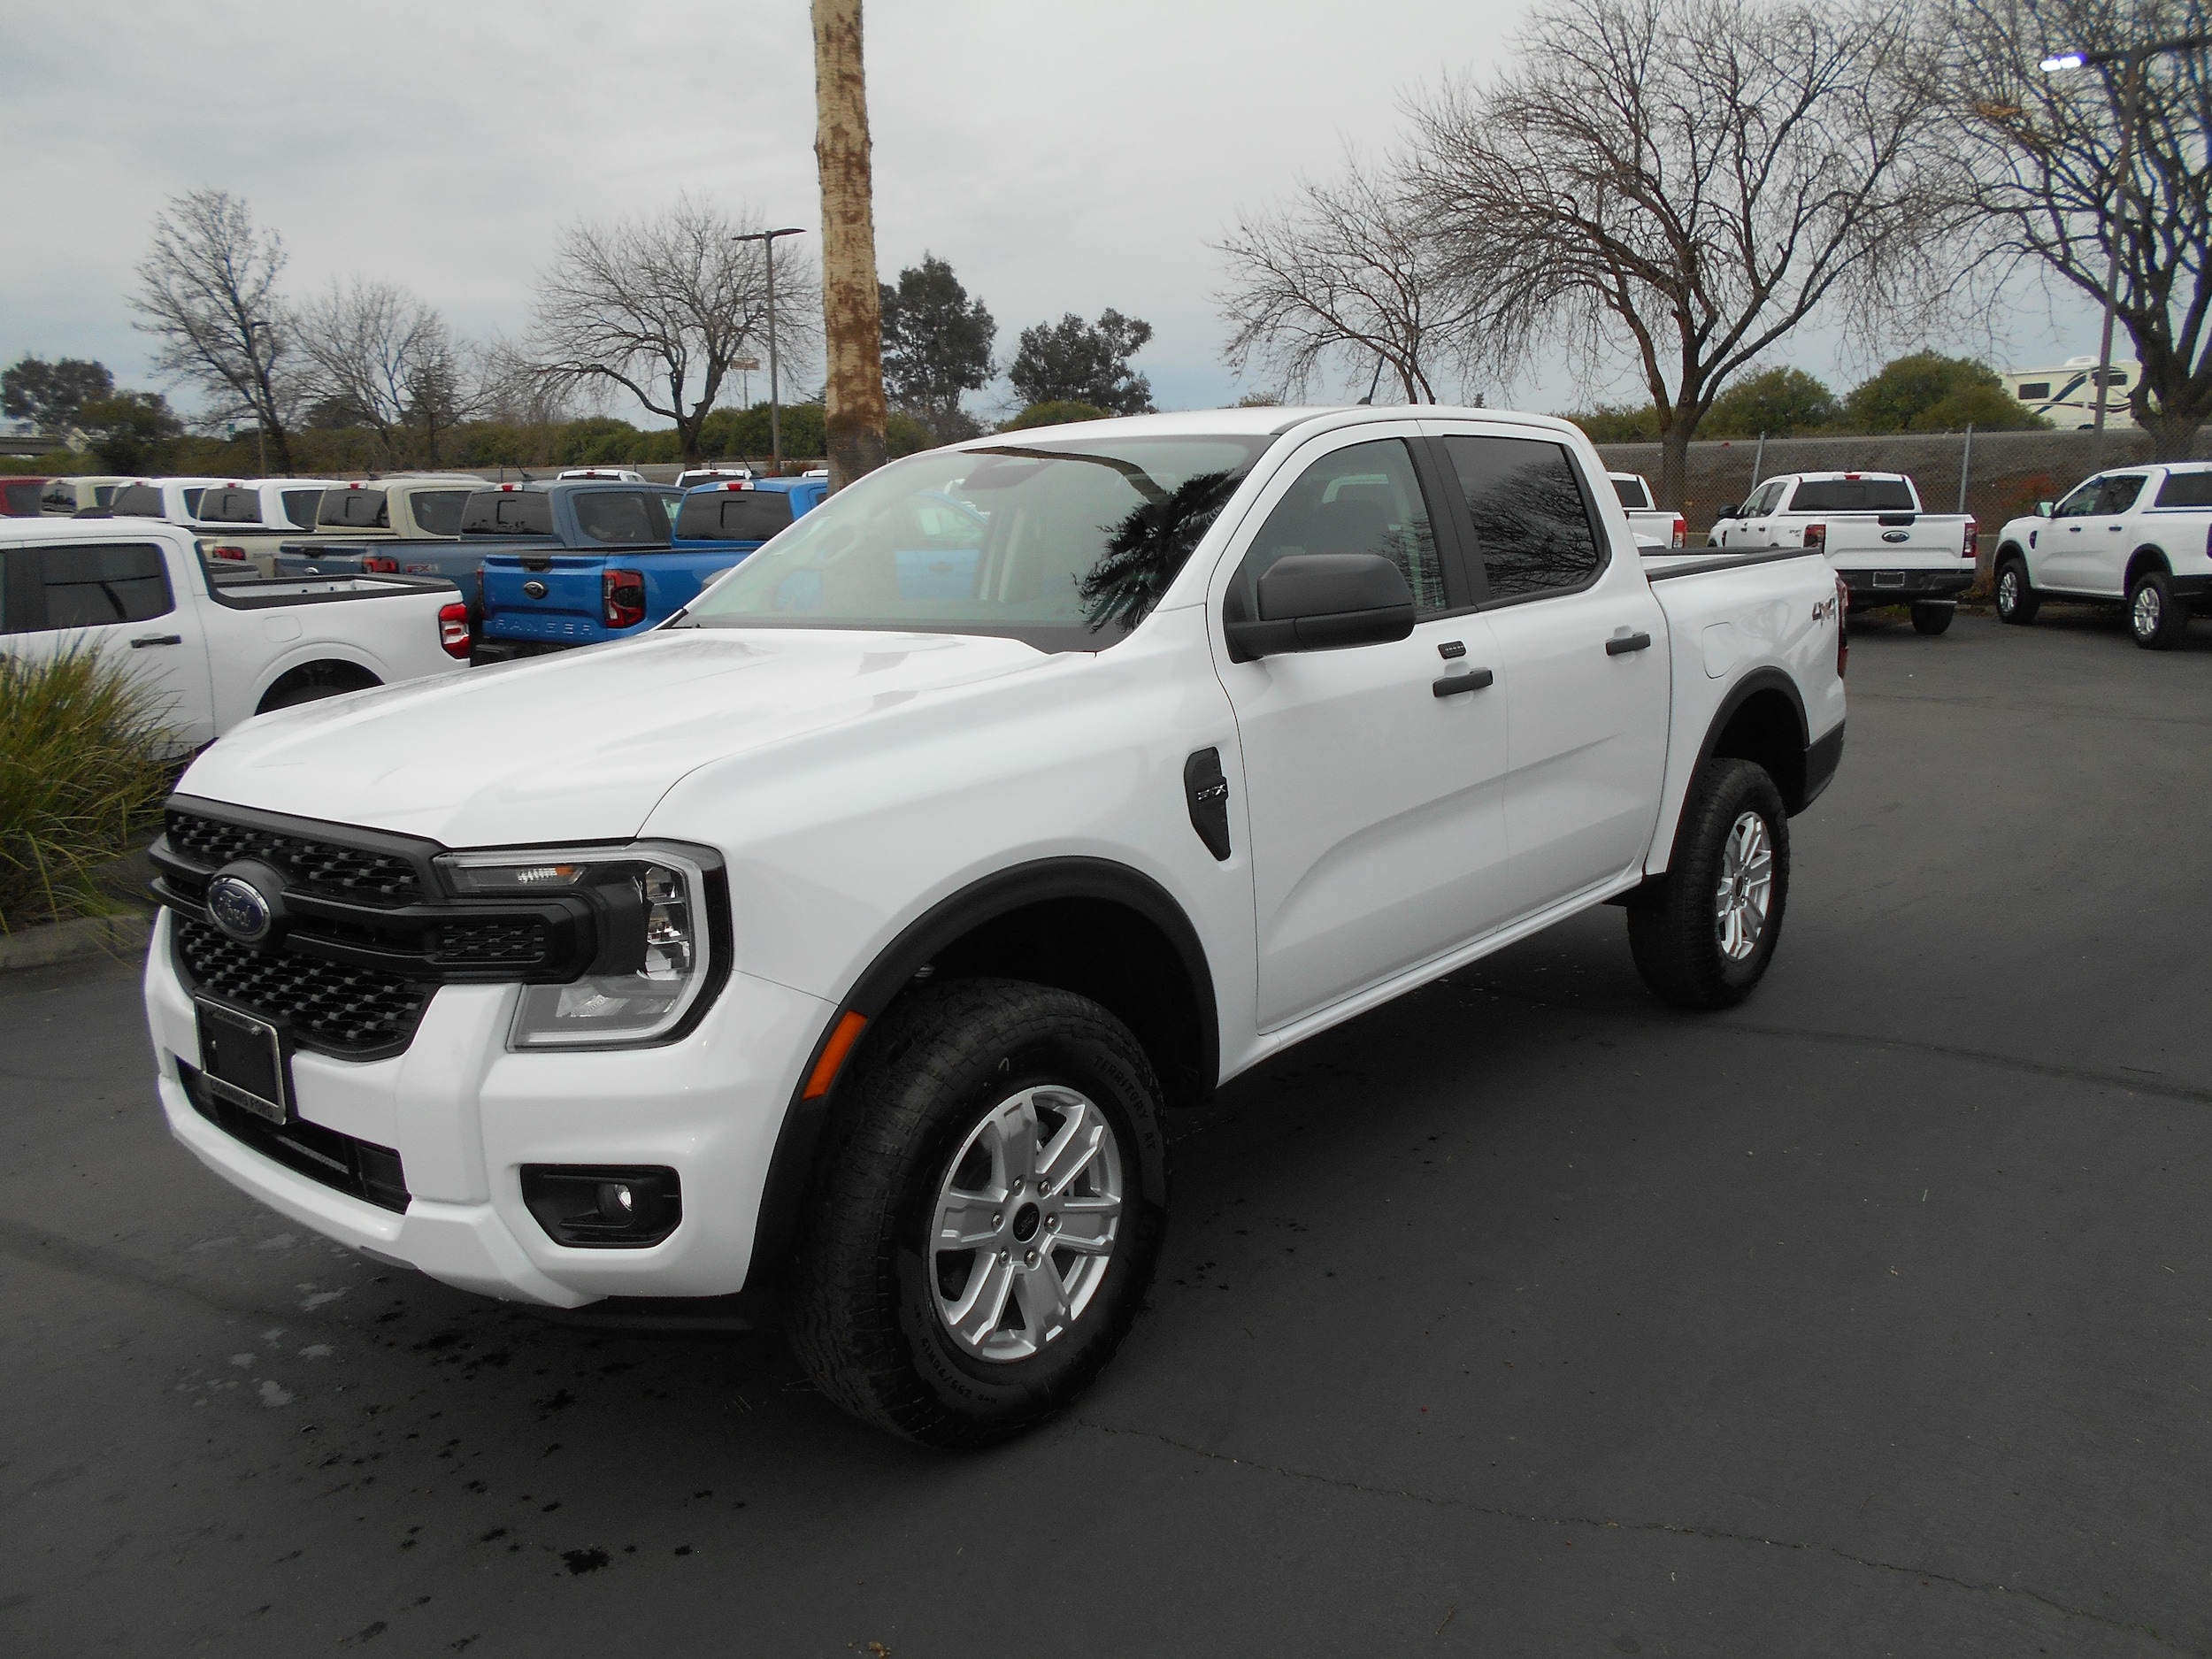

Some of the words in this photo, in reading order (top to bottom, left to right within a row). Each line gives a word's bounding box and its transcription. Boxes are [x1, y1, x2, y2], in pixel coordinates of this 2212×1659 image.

[495, 618, 594, 636] RANGER
[218, 889, 251, 926] Ford
[210, 1079, 250, 1107] CORNING
[250, 1095, 273, 1119] FORD
[1094, 1056, 1148, 1118] TERRITORY
